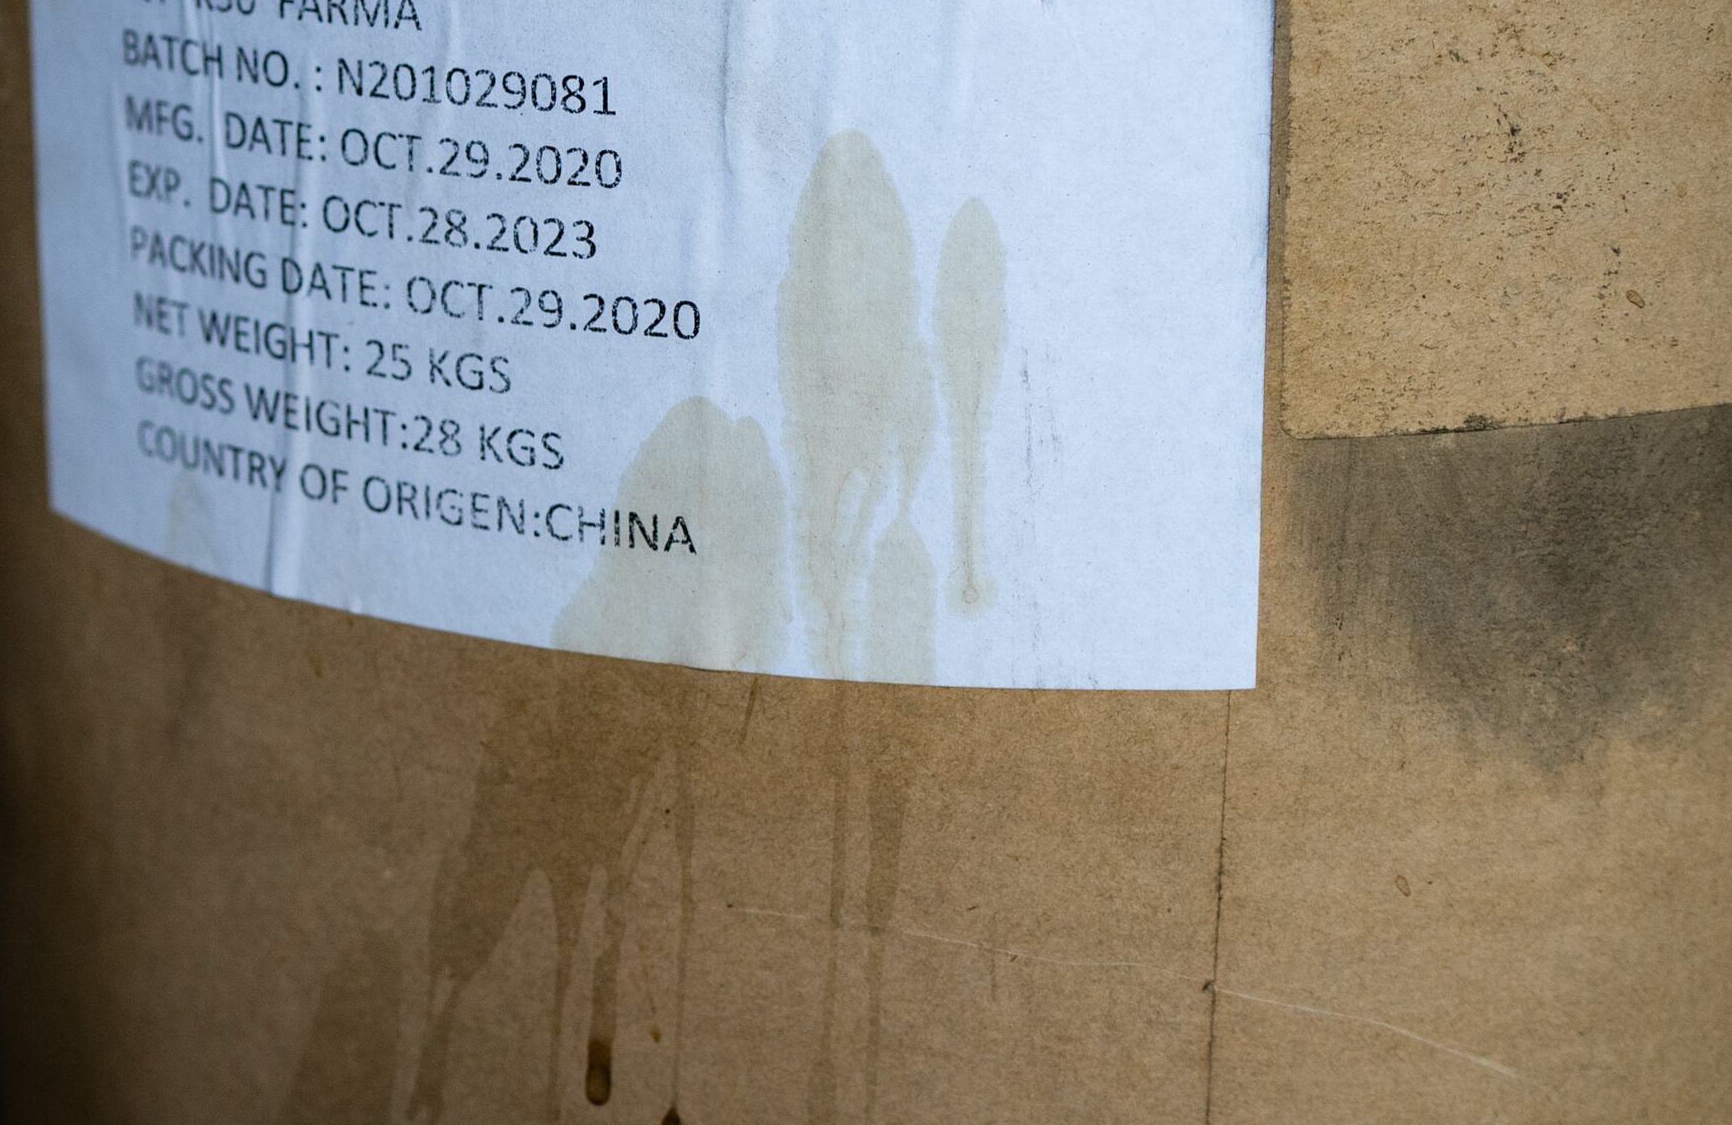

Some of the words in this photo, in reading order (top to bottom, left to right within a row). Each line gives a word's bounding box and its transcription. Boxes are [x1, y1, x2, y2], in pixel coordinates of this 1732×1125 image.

[122, 28, 223, 78] BATCH
[236, 45, 303, 90] NO.
[336, 57, 618, 117] N201029081
[125, 96, 204, 143] MFG.
[224, 110, 328, 162] DATE:
[340, 127, 624, 190] OCT.29.2020
[128, 160, 191, 206] EXP.
[208, 175, 308, 228] DATE:
[321, 195, 597, 260] OCT.28.2023
[131, 225, 269, 290] PACKING
[281, 257, 392, 311] DATE:
[405, 274, 702, 340] OCT.29.2020
[134, 292, 189, 337] NET
[199, 308, 352, 372] WEIGHT:
[365, 337, 413, 382] 25
[428, 348, 512, 395] KGS
[136, 357, 236, 415] GROSS
[244, 380, 463, 458] WEIGHT:28
[478, 422, 565, 470] KGS
[139, 420, 288, 493] COUNTRY
[299, 462, 350, 505] OF
[362, 474, 699, 556] ORIGEN:CHINA
